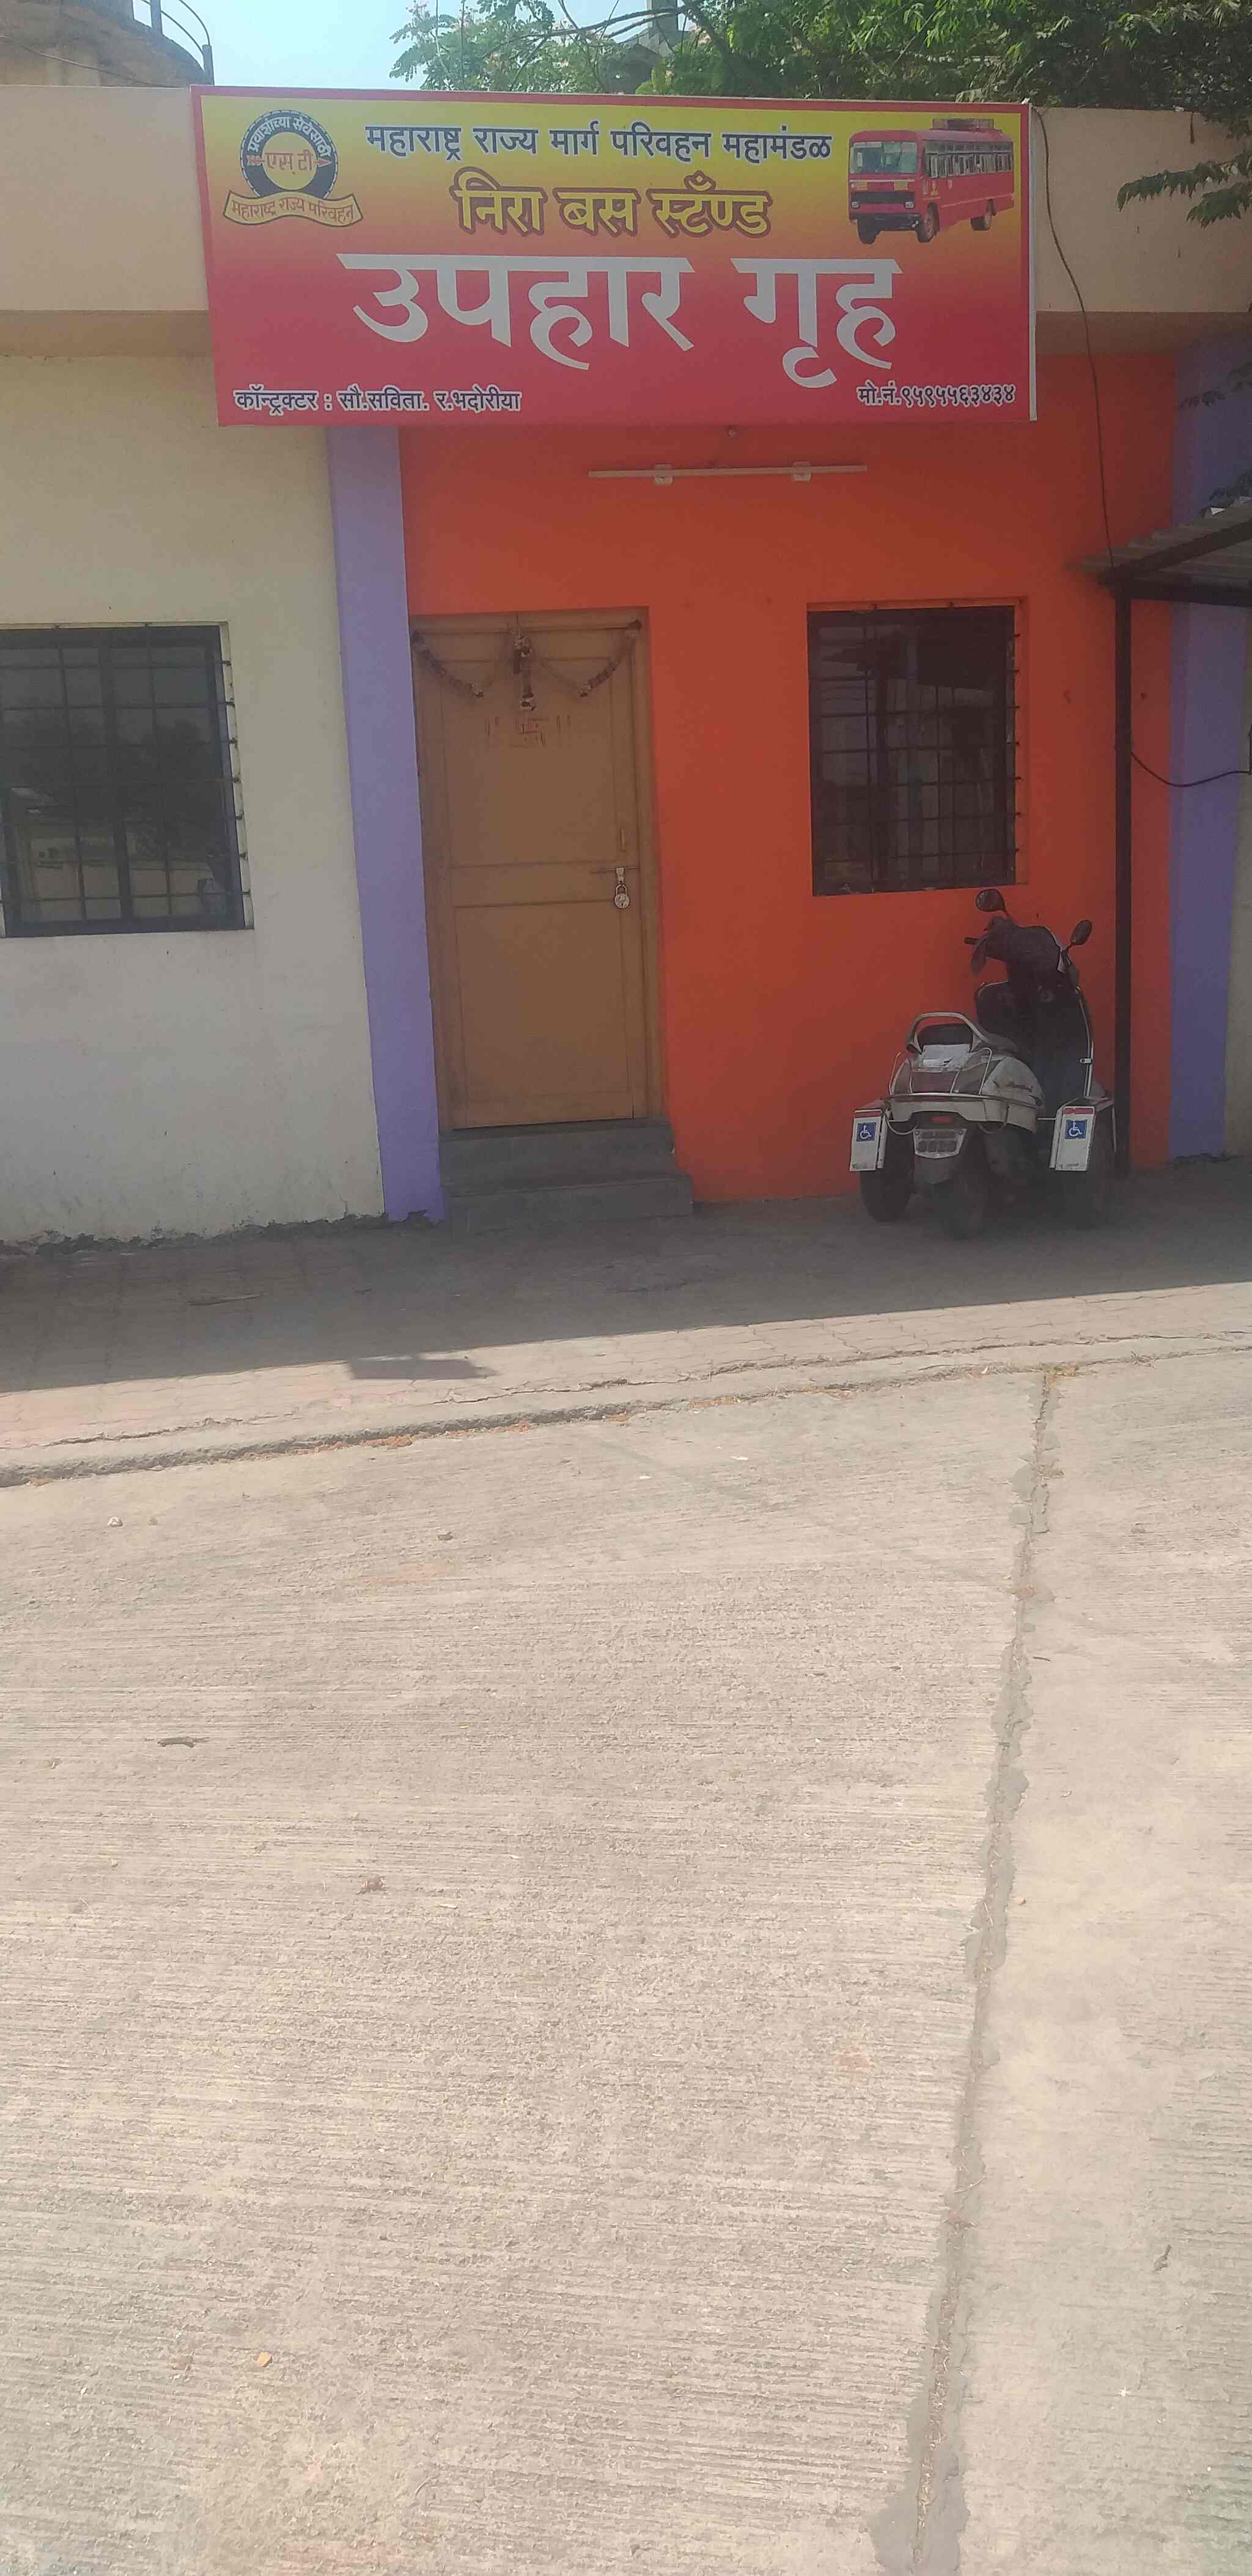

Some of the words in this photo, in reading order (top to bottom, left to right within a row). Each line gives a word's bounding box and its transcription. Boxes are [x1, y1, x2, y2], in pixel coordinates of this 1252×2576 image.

[365, 126, 462, 161] महाराष्ट्र
[473, 127, 539, 154] राज्य
[550, 120, 599, 155] मार्ग
[610, 122, 712, 163] परिवहन
[722, 125, 832, 163] महामंडळ
[279, 197, 305, 211] राज्य
[308, 201, 353, 224] परिवहन
[451, 167, 548, 235] निरा
[553, 187, 641, 235] बस
[646, 170, 773, 238] स्टँण्ड
[336, 253, 694, 370] उपहार
[731, 258, 902, 388] गृह
